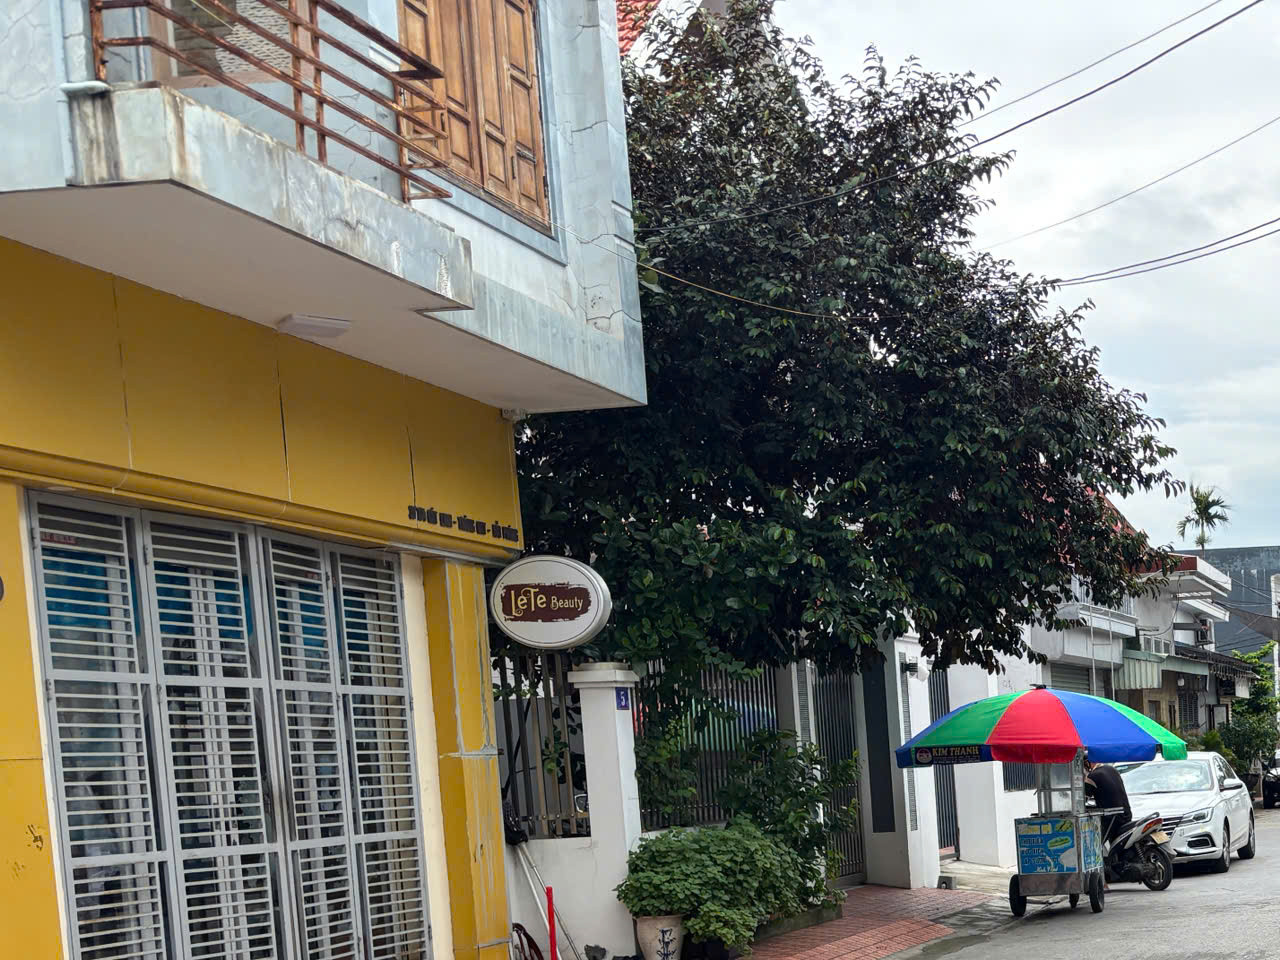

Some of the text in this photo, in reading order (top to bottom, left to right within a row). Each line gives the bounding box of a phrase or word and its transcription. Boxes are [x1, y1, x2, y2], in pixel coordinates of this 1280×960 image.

[511, 587, 583, 616] LeTe Beauty
[619, 691, 626, 706] 5
[932, 746, 979, 756] KIM THANH
